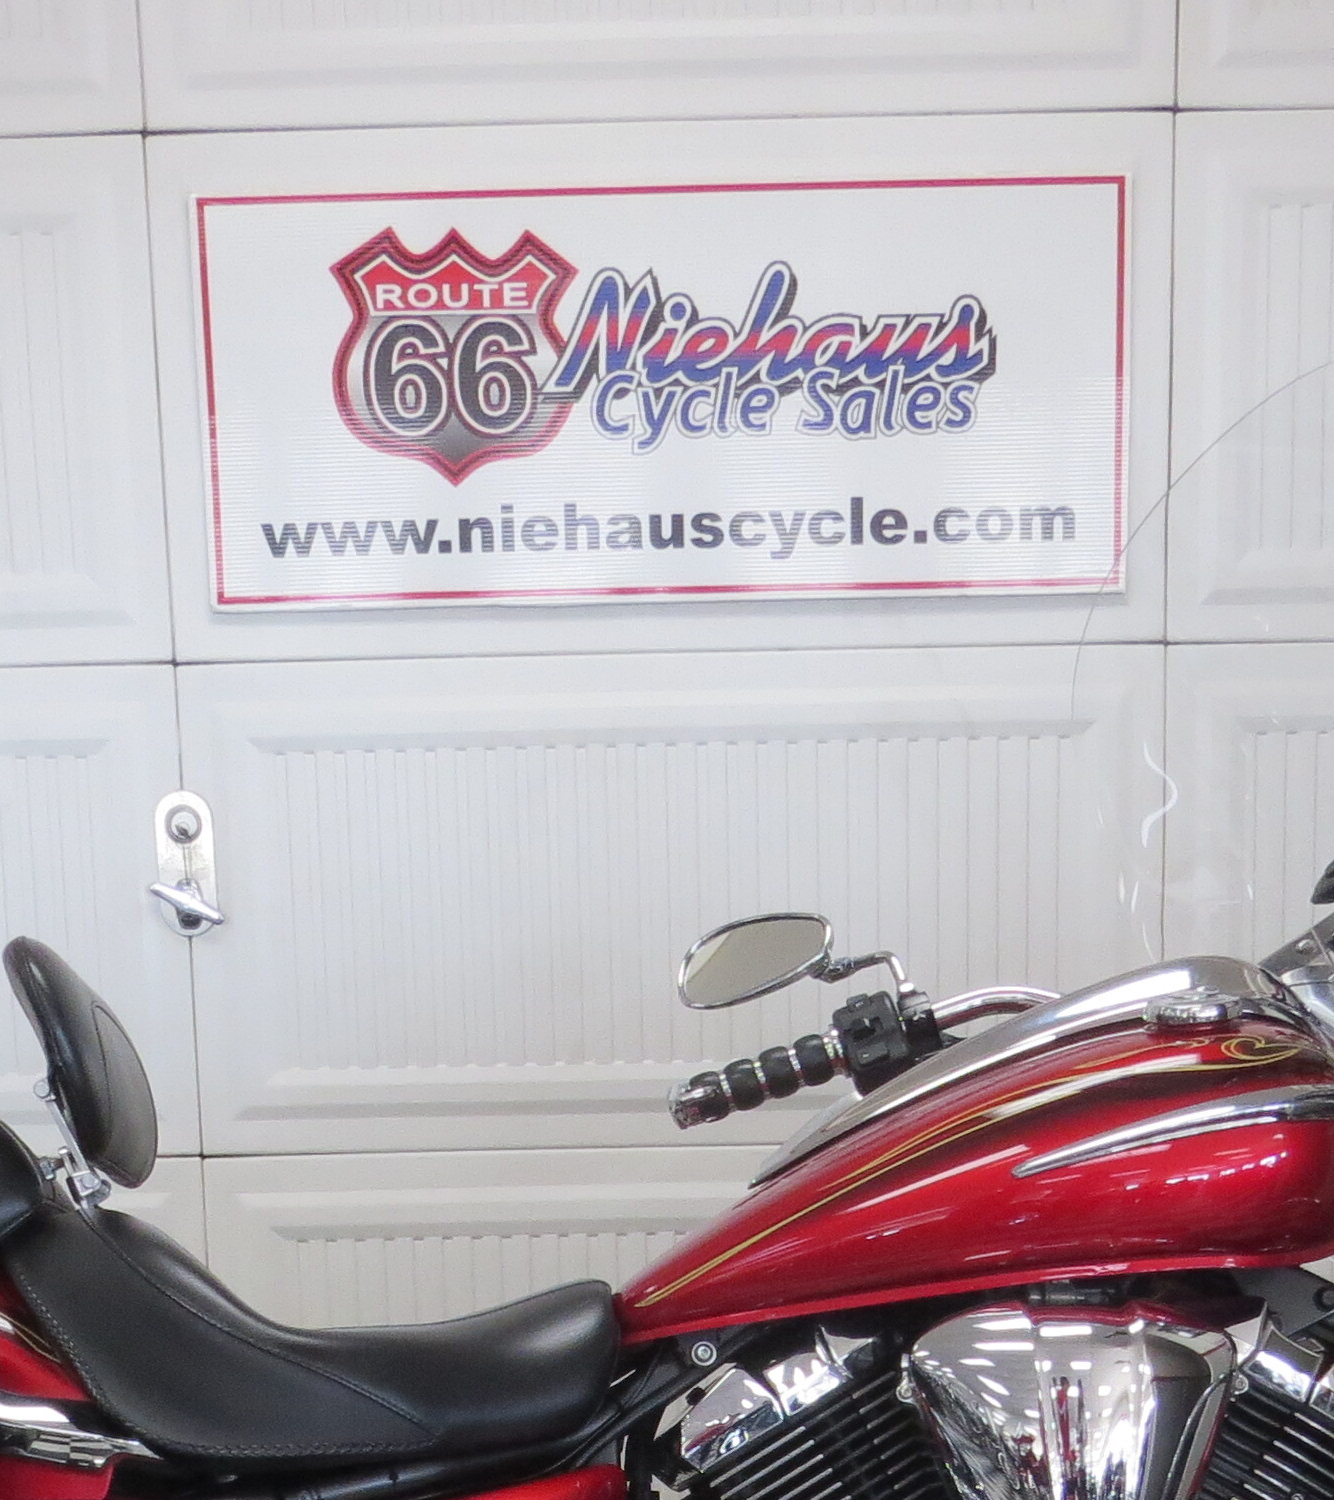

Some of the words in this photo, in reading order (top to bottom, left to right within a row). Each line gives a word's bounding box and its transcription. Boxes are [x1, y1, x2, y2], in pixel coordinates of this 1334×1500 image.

[375, 281, 529, 309] ROUTE
[538, 261, 996, 400] Niehaus
[364, 315, 537, 437] 66
[592, 366, 776, 454] Cycle
[798, 366, 980, 440] Sales
[261, 497, 1076, 559] www.niehauscycle.com
